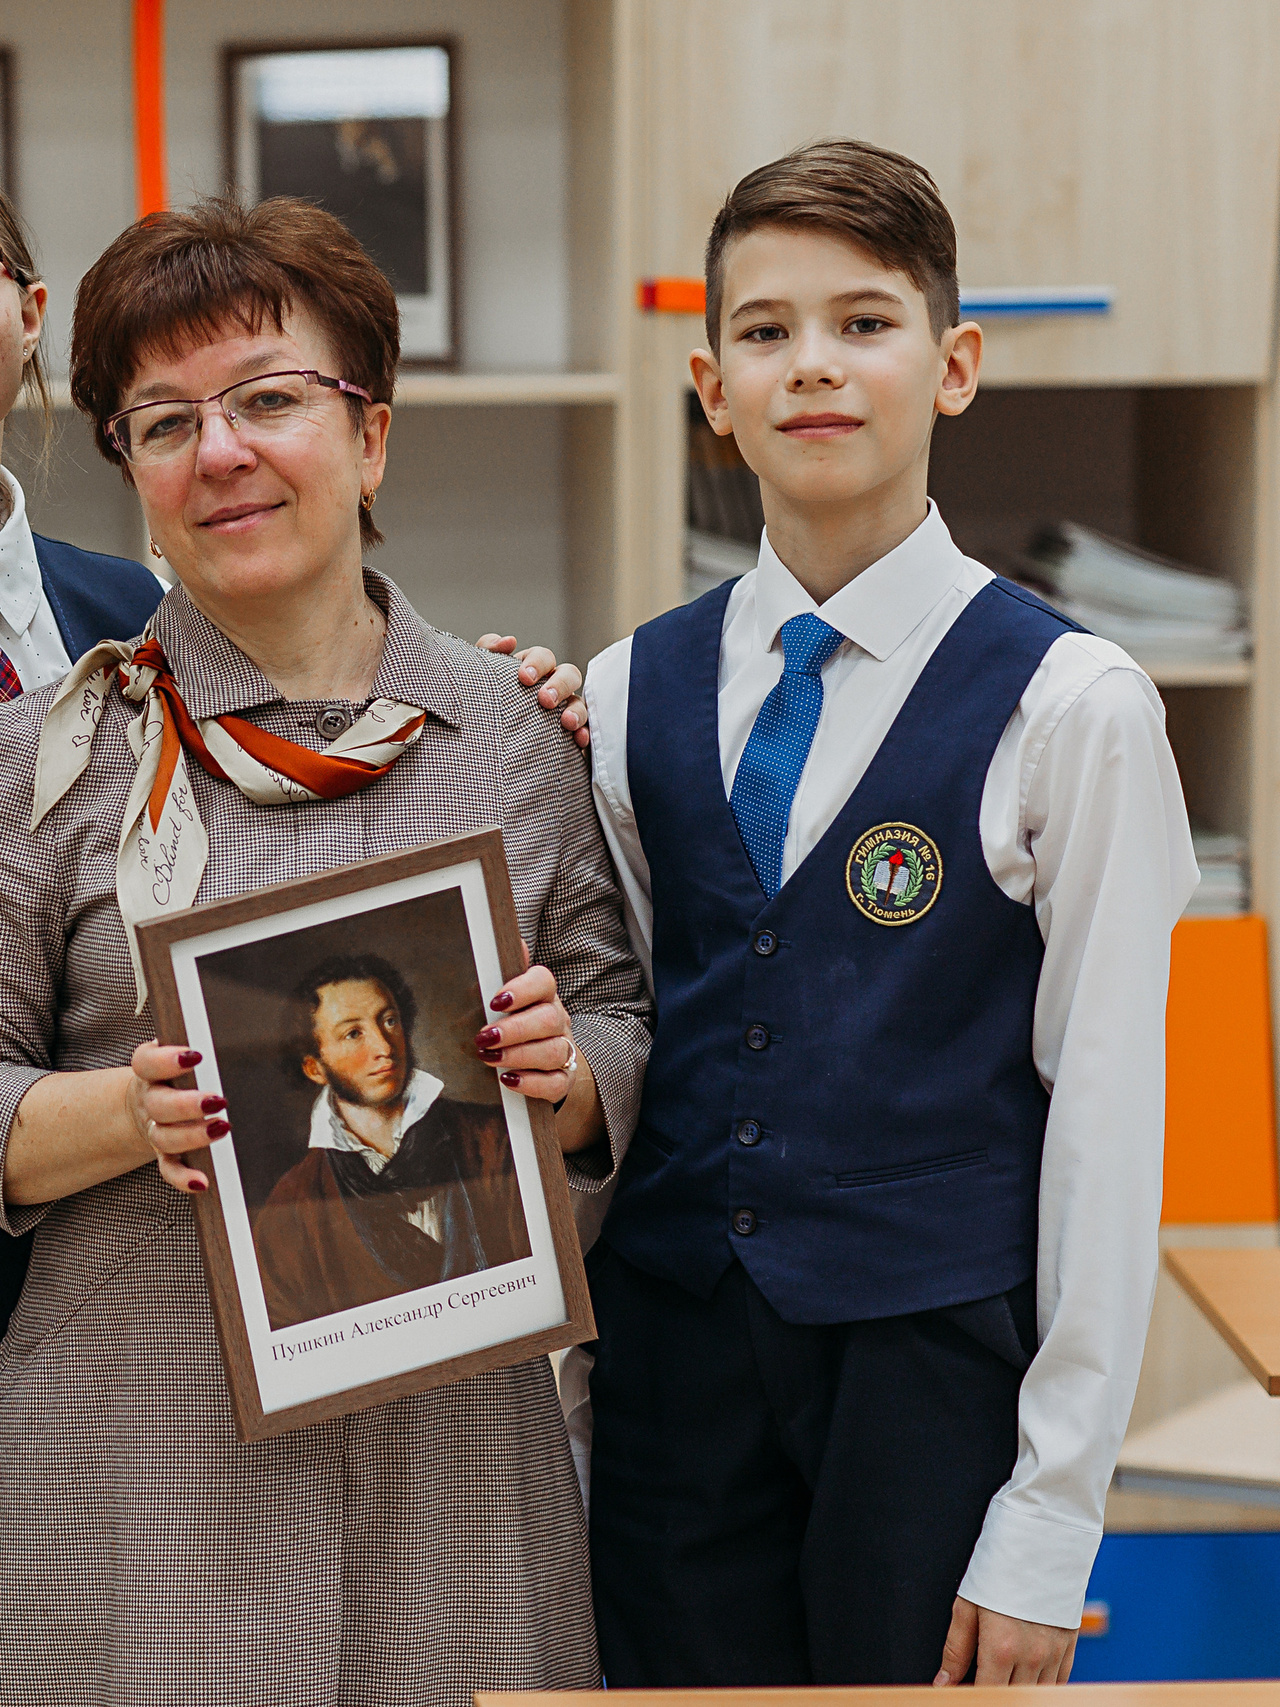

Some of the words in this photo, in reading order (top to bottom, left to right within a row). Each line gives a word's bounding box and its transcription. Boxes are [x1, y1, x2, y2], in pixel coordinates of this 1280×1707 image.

[171, 783, 194, 822] for
[855, 829, 920, 865] ГИМНАЗИЯ
[925, 864, 935, 881] 16
[866, 901, 916, 919] Тюмень
[271, 1330, 345, 1361] Пушкин
[351, 1301, 443, 1339] Александр
[447, 1274, 537, 1309] Сергеевич
